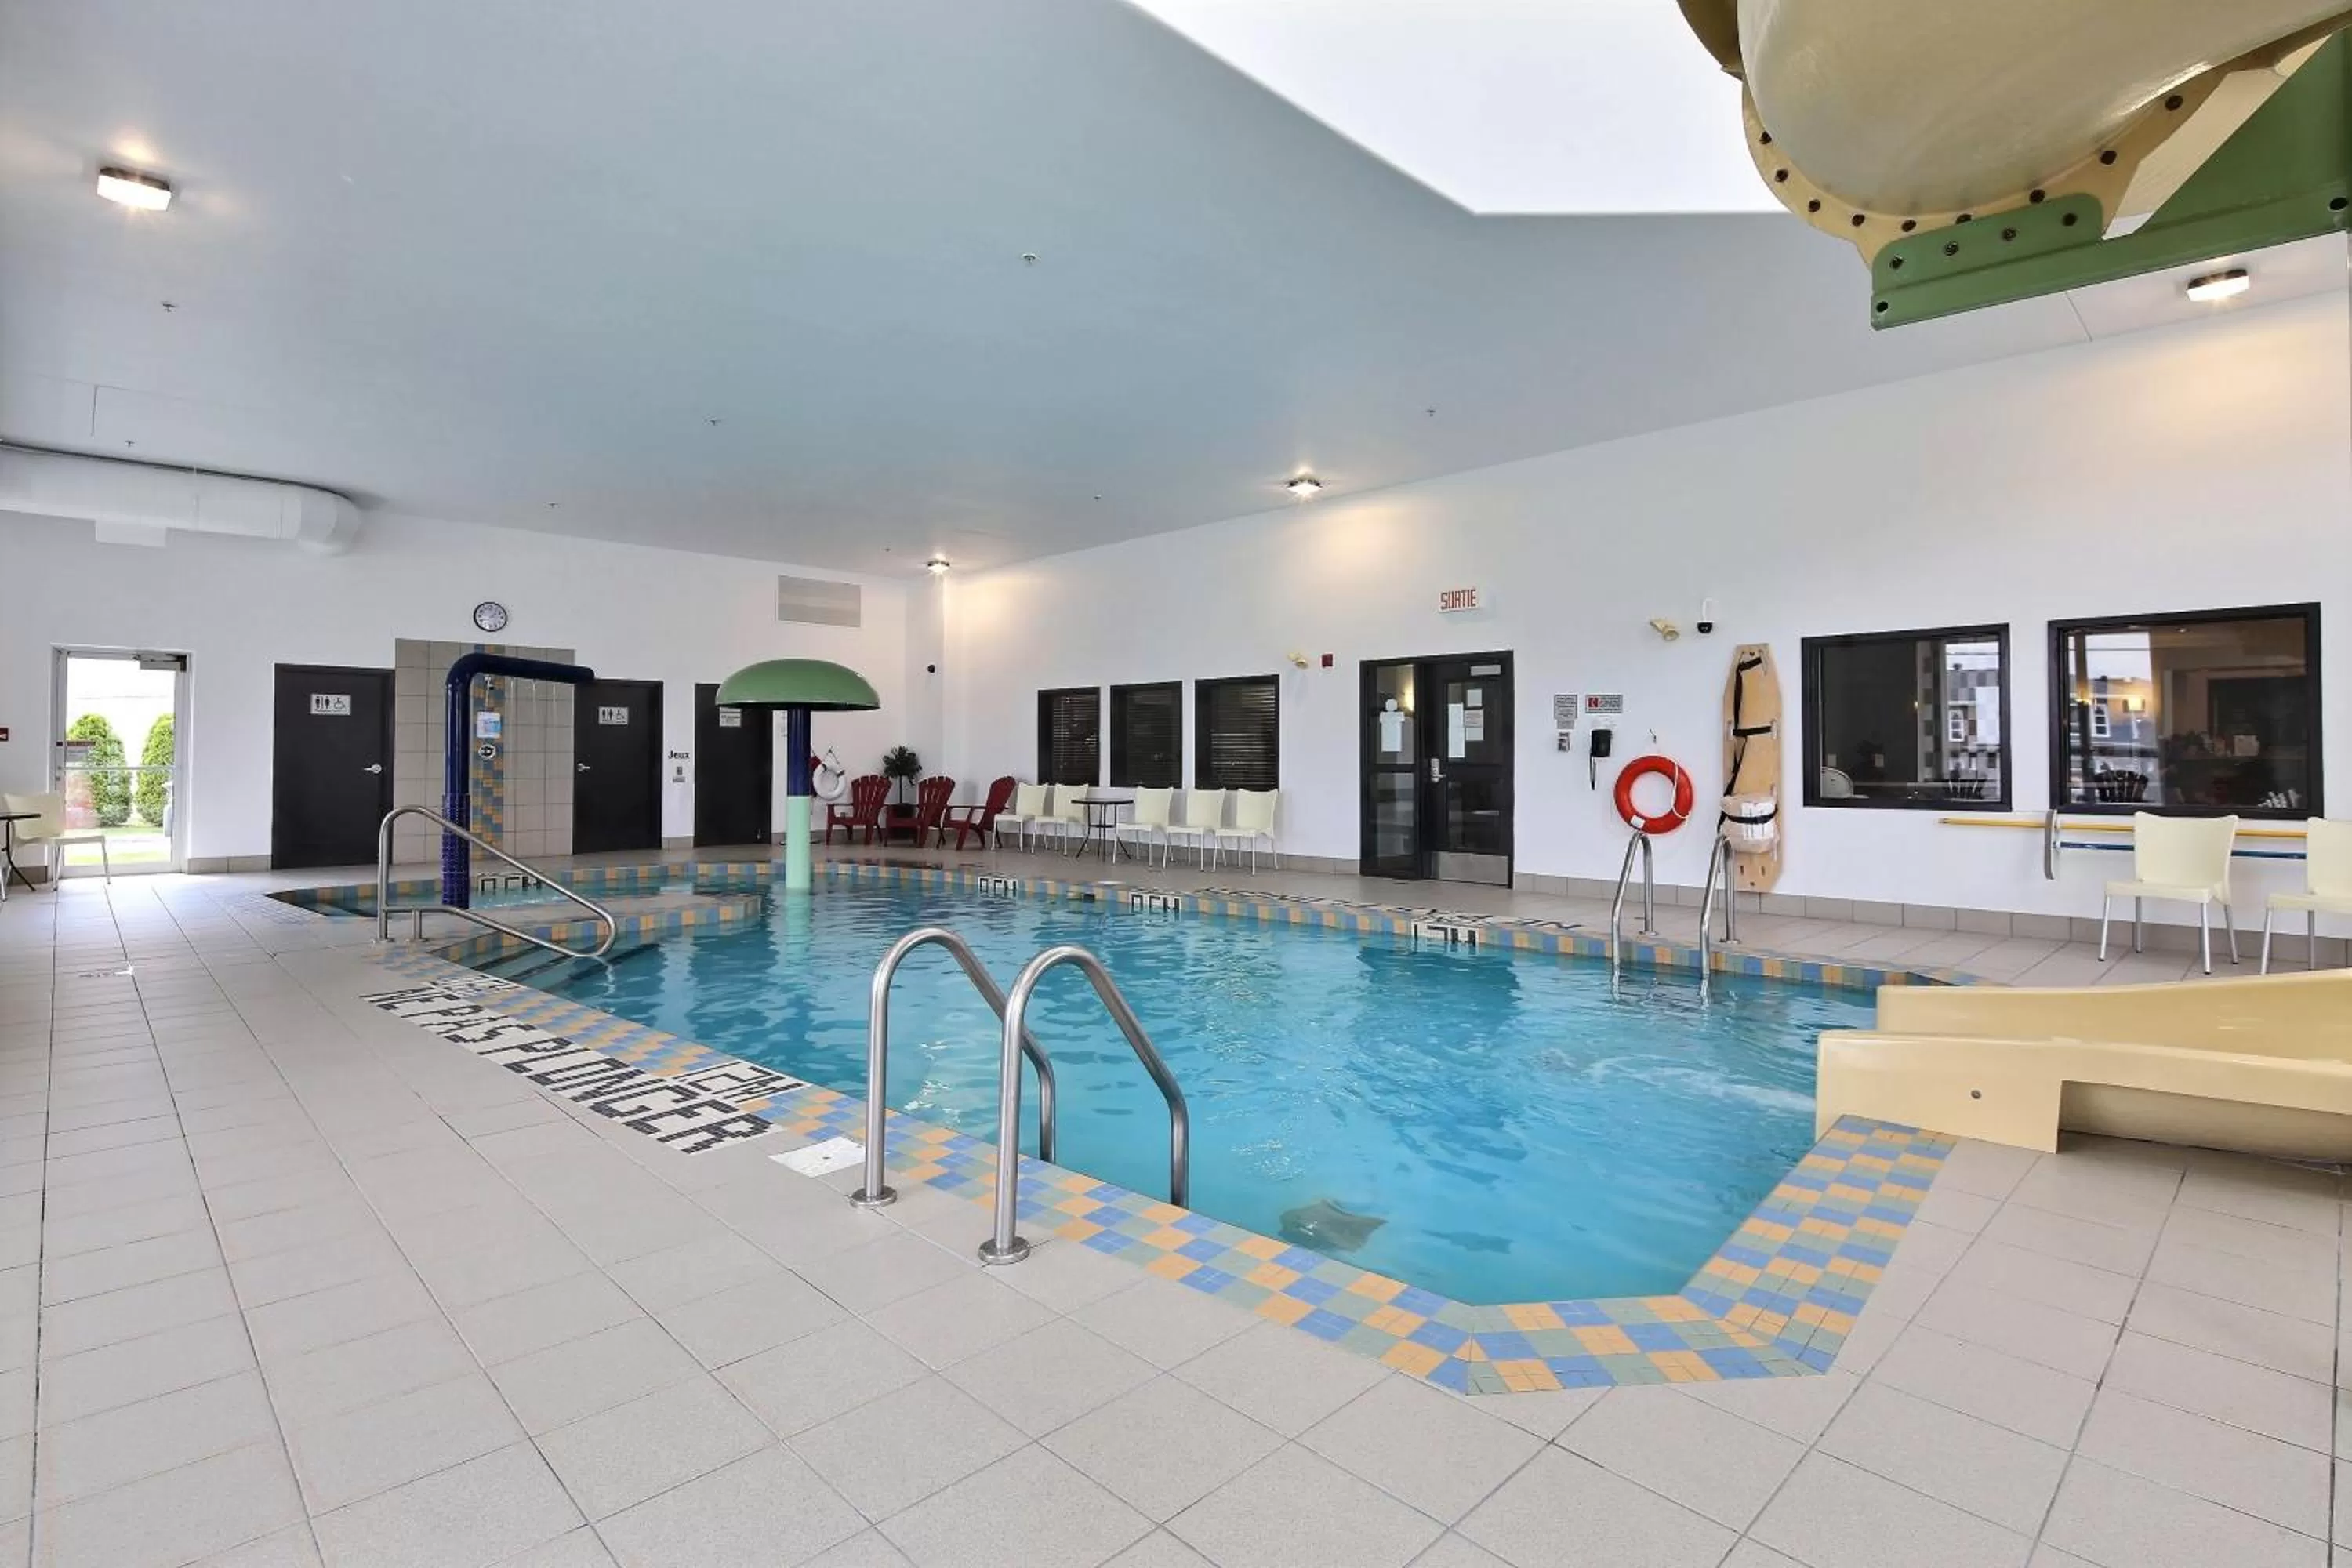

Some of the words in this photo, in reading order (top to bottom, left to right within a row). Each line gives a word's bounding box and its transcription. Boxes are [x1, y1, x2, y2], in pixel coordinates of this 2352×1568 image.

[1440, 589, 1476, 610] SORTIE
[667, 750, 690, 760] Jeux
[359, 986, 461, 1011] NE
[401, 1004, 537, 1044] PAS
[477, 1037, 774, 1155] PLONGER
